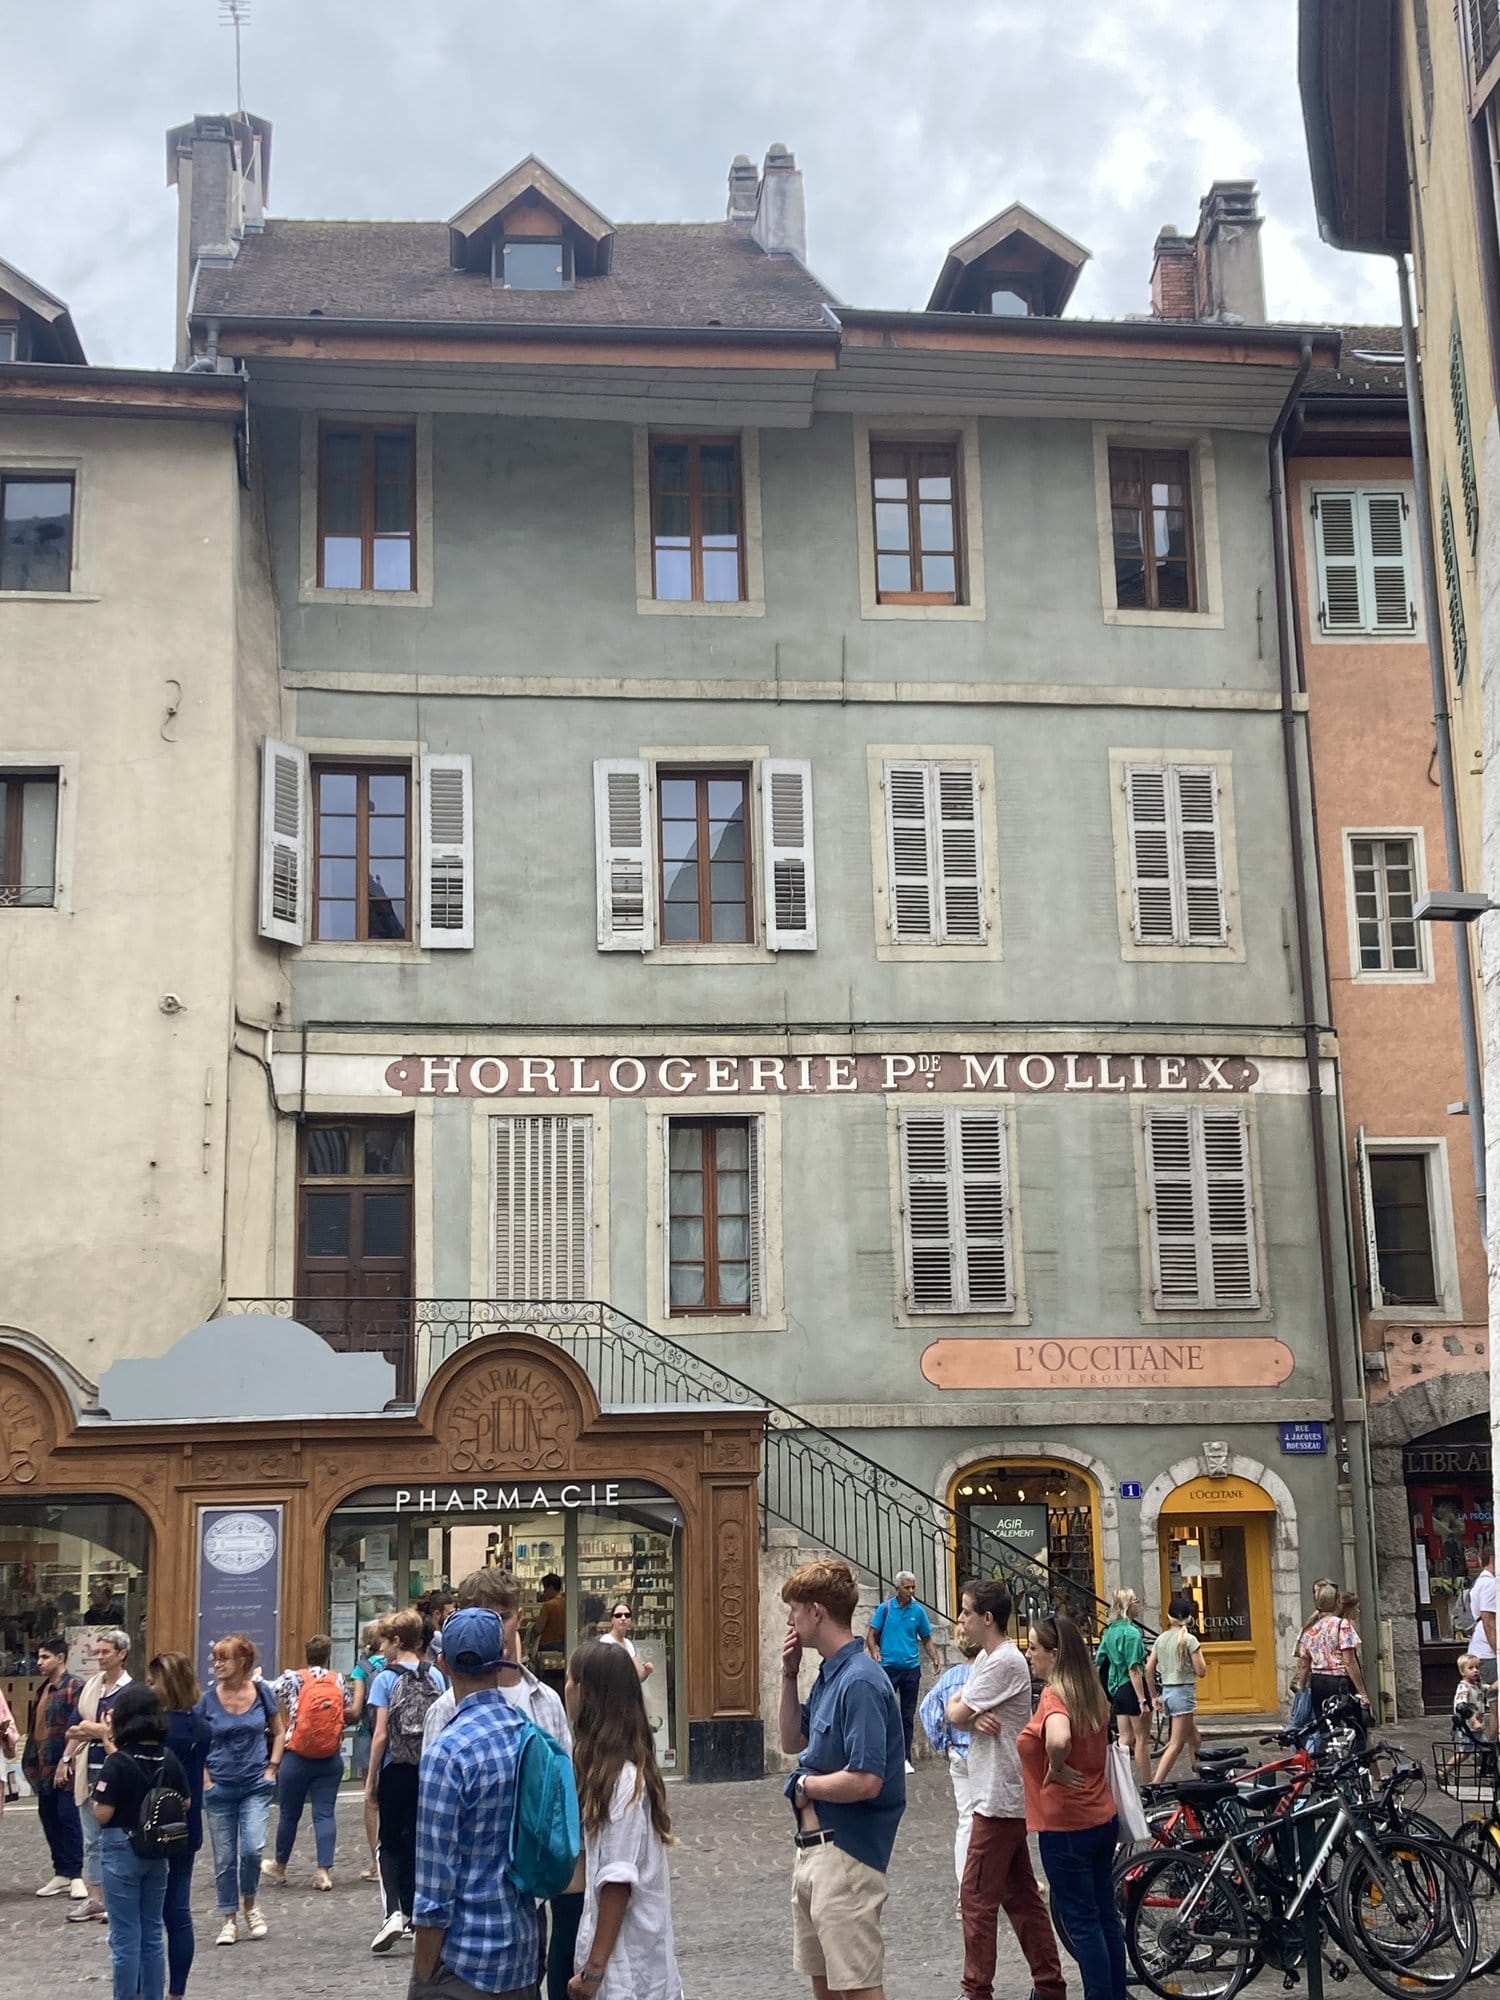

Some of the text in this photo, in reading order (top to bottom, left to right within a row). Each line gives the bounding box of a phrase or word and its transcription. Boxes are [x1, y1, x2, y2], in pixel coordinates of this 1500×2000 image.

[420, 1055, 858, 1094] HORLOGERIE
[960, 1054, 1233, 1091] MOLLIEX
[1015, 1341, 1204, 1371] L'OCCITANE
[1050, 1373, 1171, 1384] EN PROVENCE
[453, 1368, 565, 1423] PHARMACIE
[475, 1396, 543, 1454] PICON
[396, 1484, 619, 1512] PHARMACIE
[1190, 1489, 1244, 1500] L'OCCITANE
[997, 1519, 1022, 1530] AGIR
